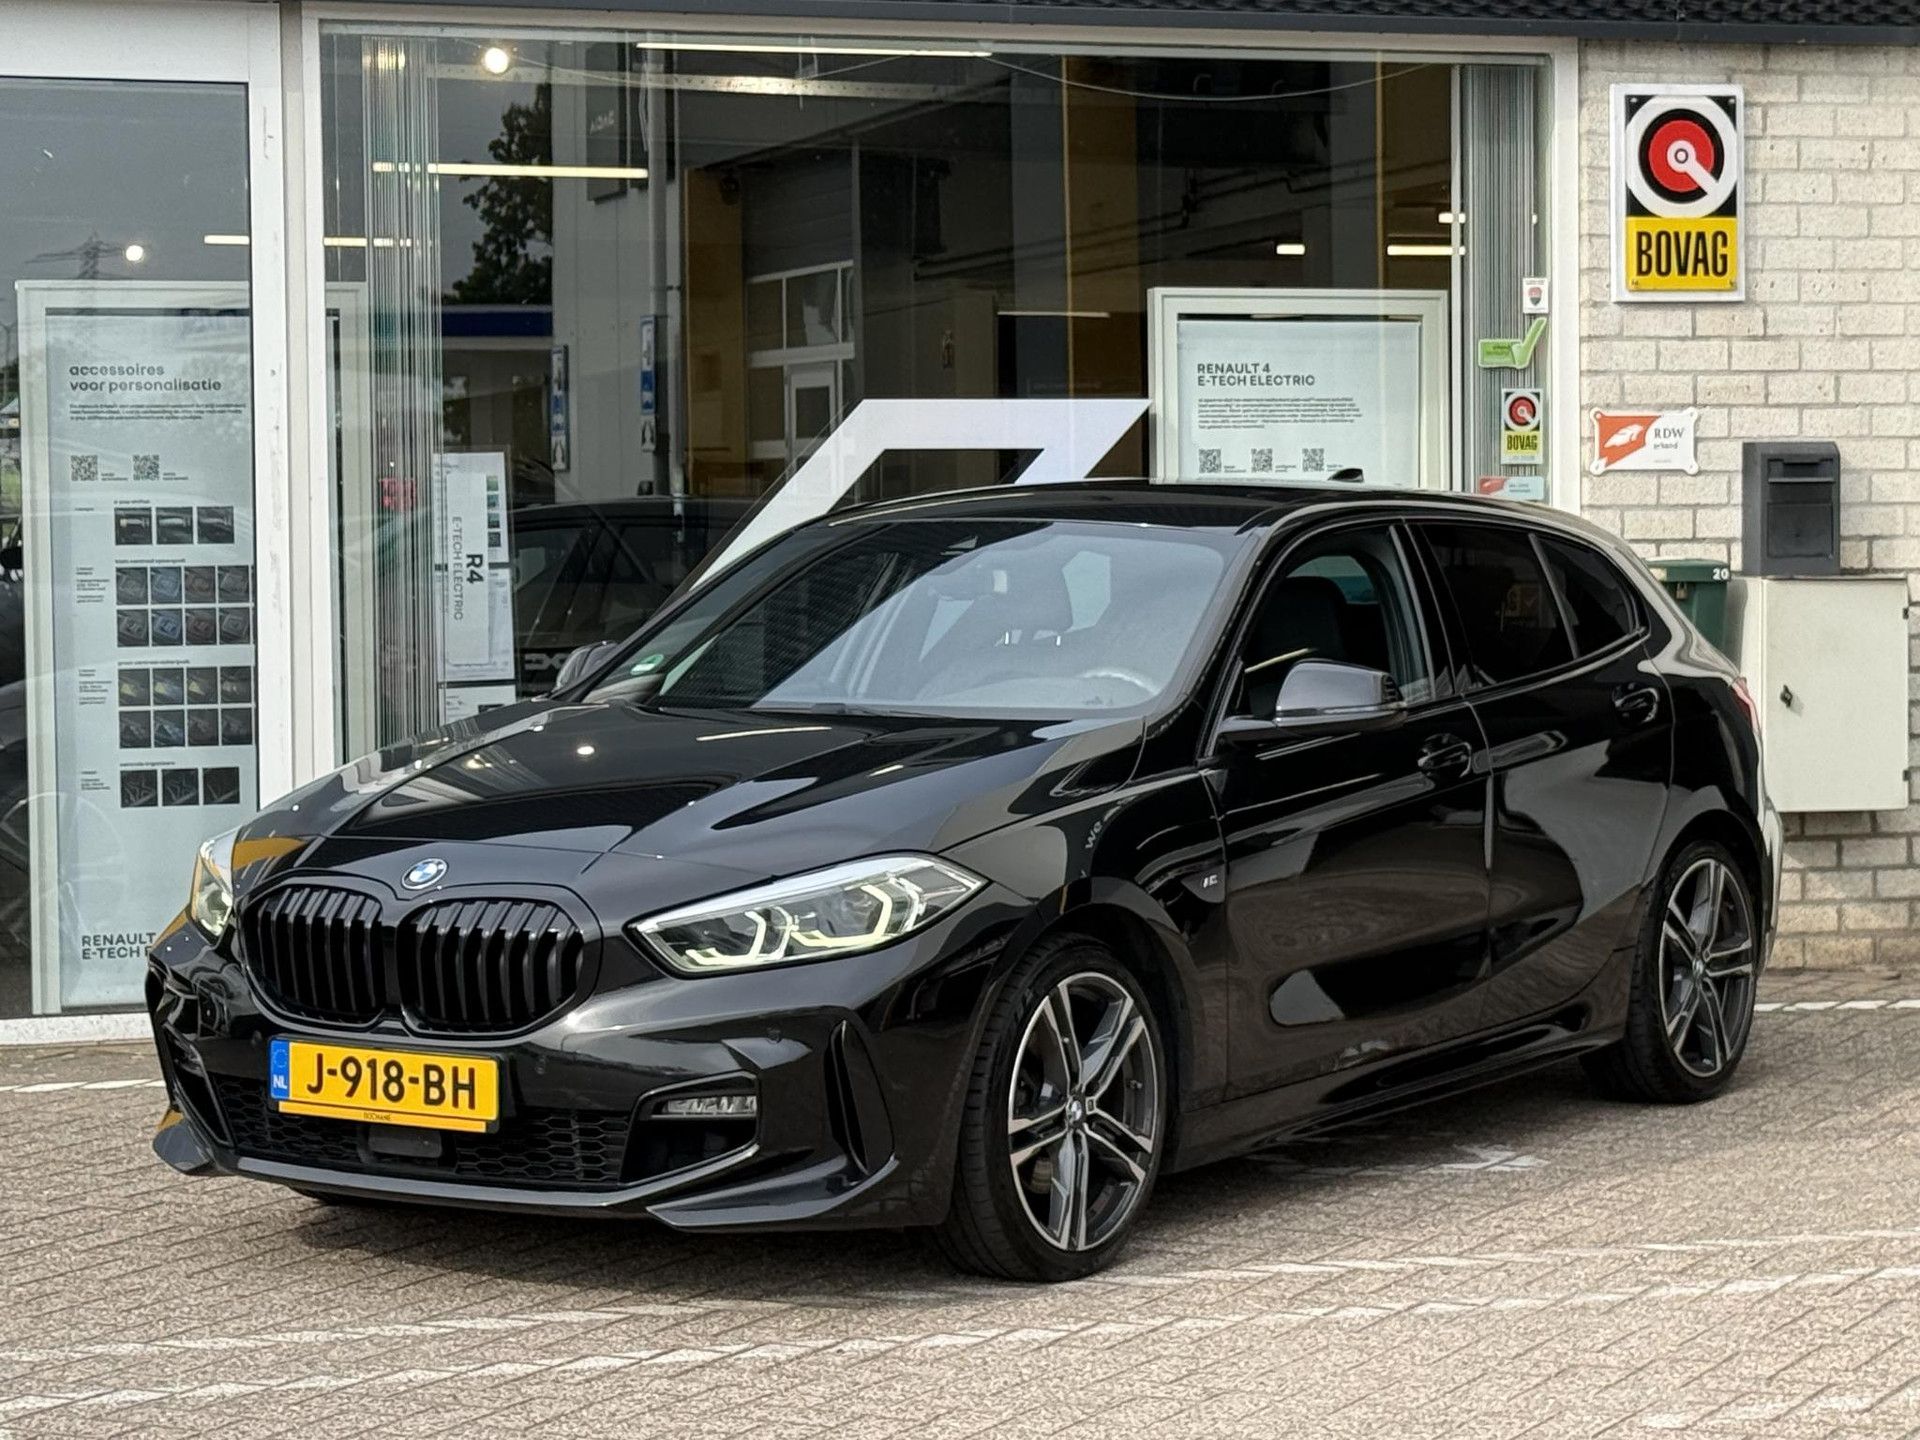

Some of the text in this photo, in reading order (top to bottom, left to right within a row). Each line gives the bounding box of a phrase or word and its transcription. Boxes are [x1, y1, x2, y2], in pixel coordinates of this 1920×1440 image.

[1636, 230, 1728, 278] BOVAG
[69, 364, 165, 376] accessoires
[1197, 363, 1271, 374] RENAULT 4
[70, 379, 222, 393] voor personalisatie
[1197, 375, 1315, 386] E-TECH ELECTRIC
[1654, 428, 1685, 439] RDW
[1506, 434, 1538, 451] BOVAG
[452, 516, 464, 621] E-TECH ELECTRIC
[466, 553, 484, 584] R4
[1712, 568, 1729, 580] 20
[82, 932, 156, 947] RENAULT
[82, 946, 140, 960] E-TECH
[273, 1074, 288, 1090] NL
[306, 1052, 476, 1111] J-918-BH
